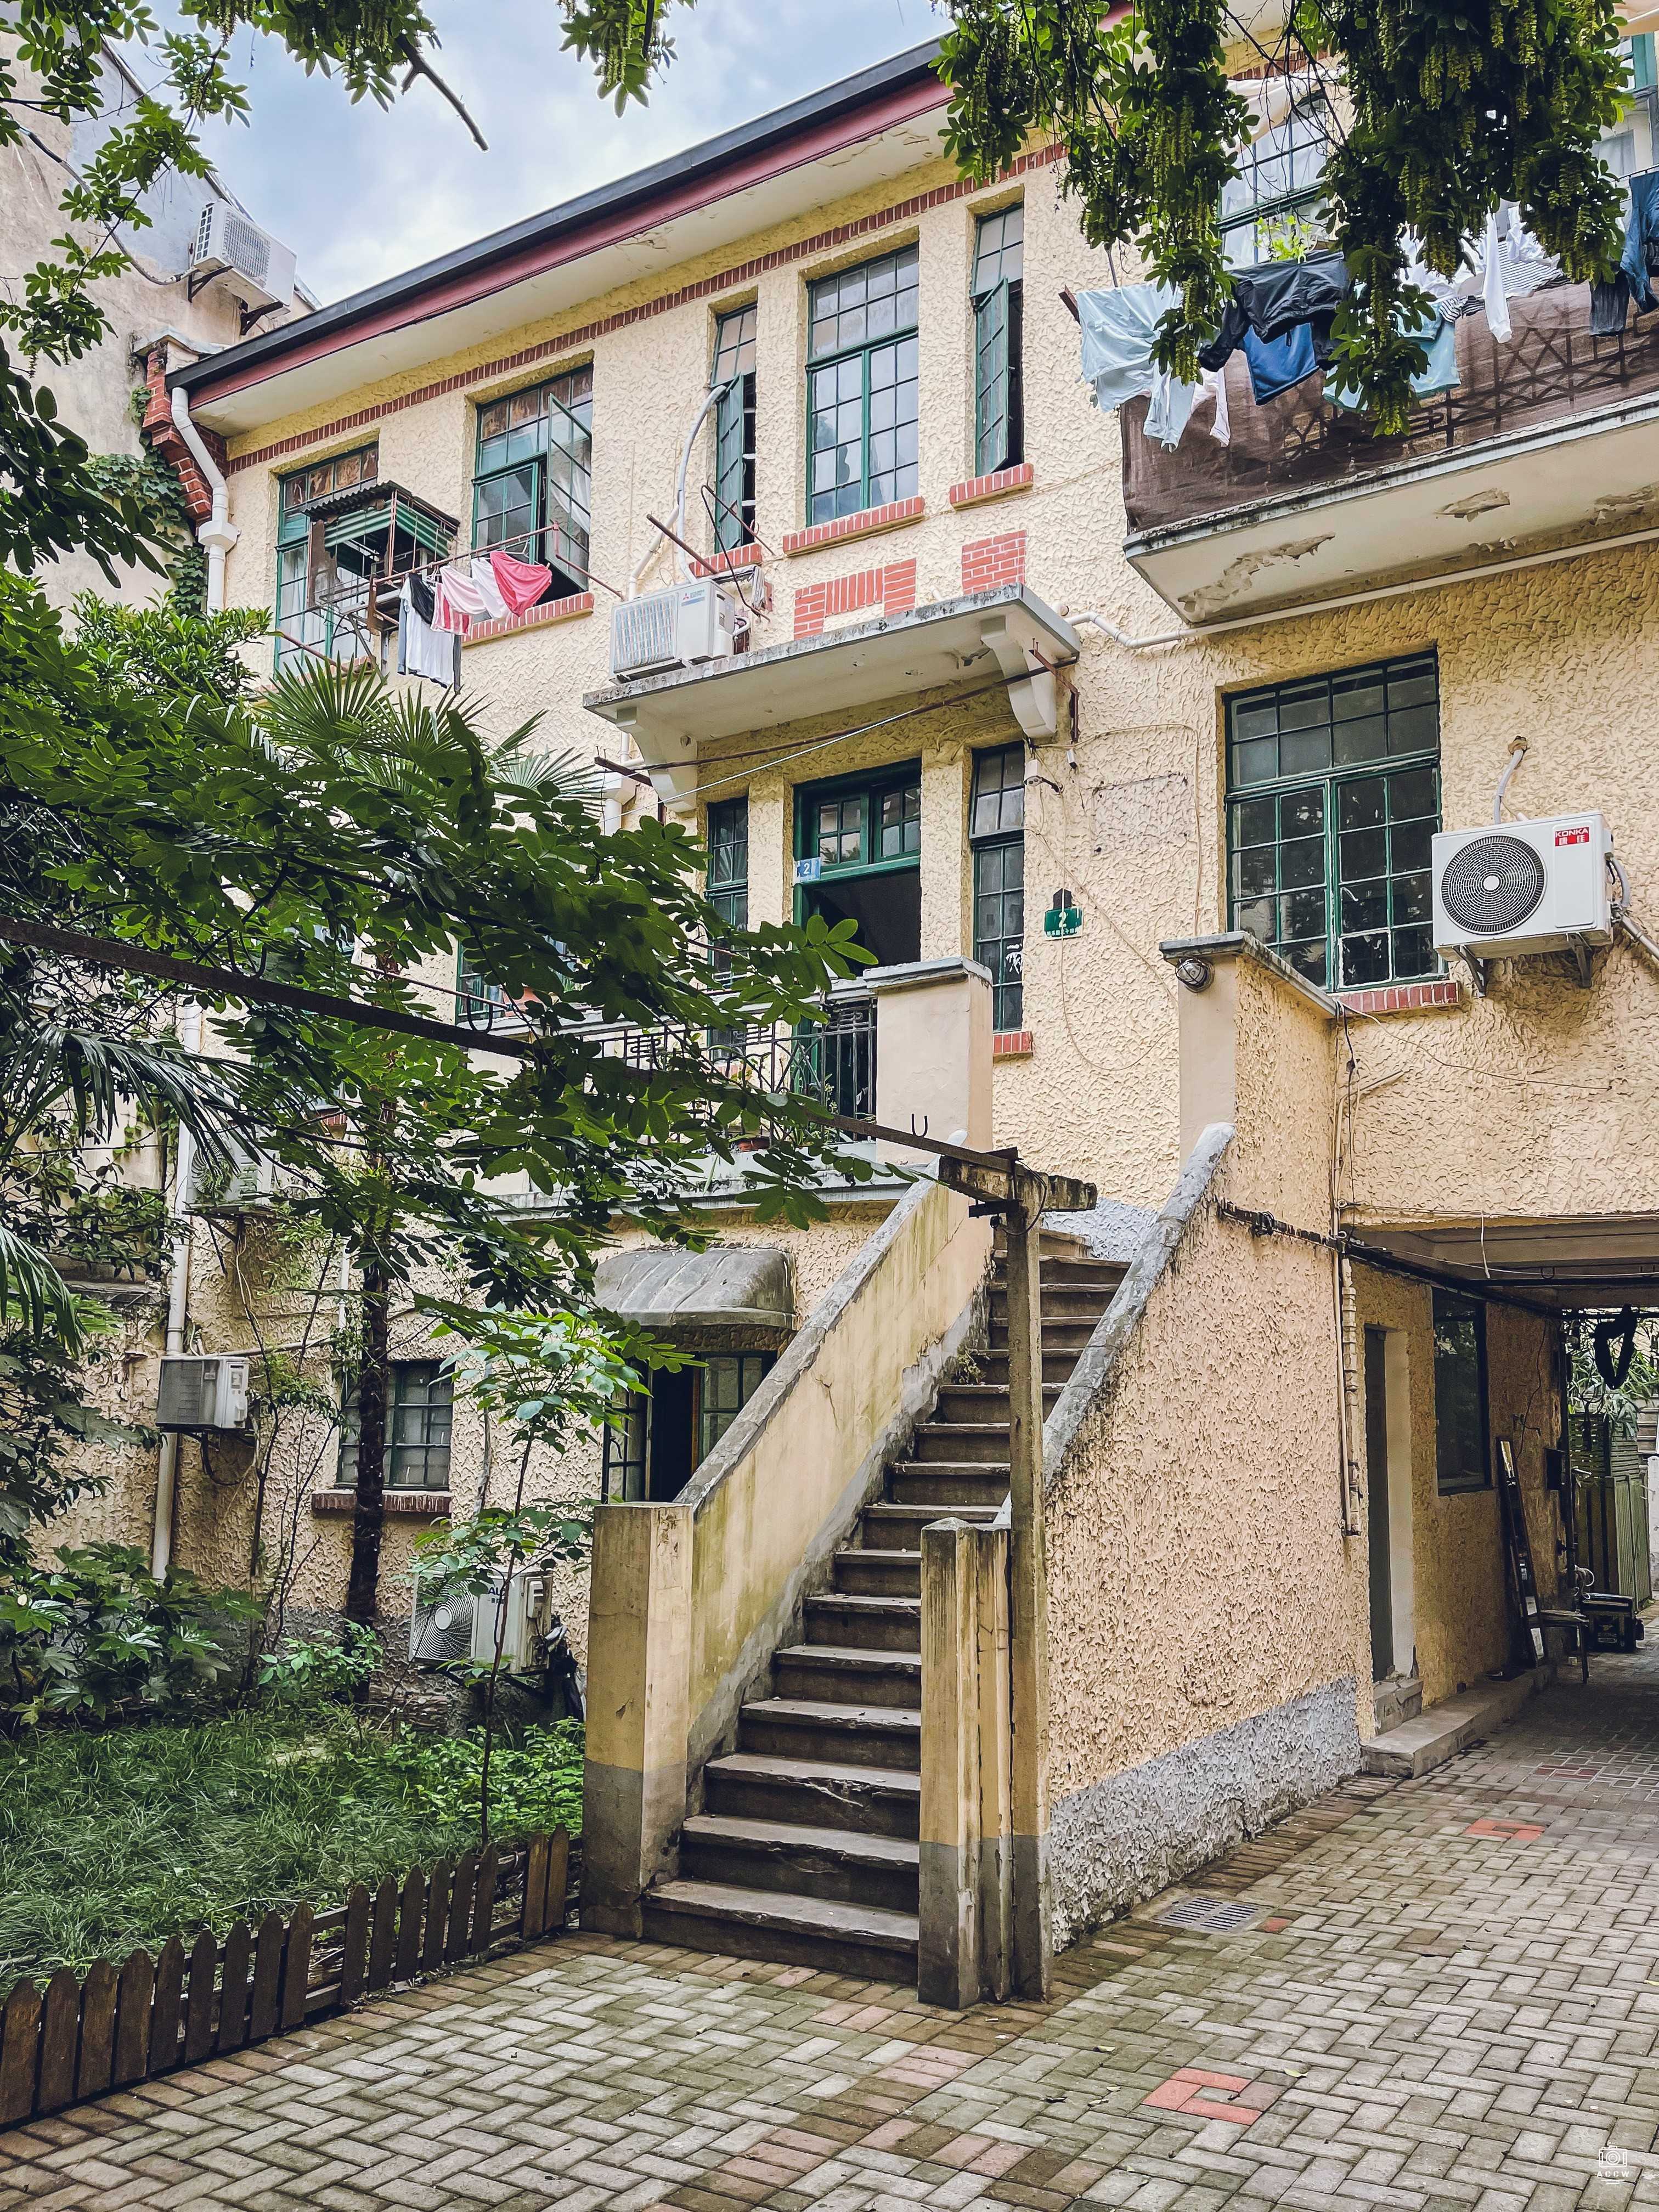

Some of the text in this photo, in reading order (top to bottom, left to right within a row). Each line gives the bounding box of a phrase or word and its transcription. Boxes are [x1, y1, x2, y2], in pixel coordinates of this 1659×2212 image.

[1555, 828, 1588, 838] KONKA
[803, 862, 810, 874] 2
[1058, 911, 1067, 928] 2
